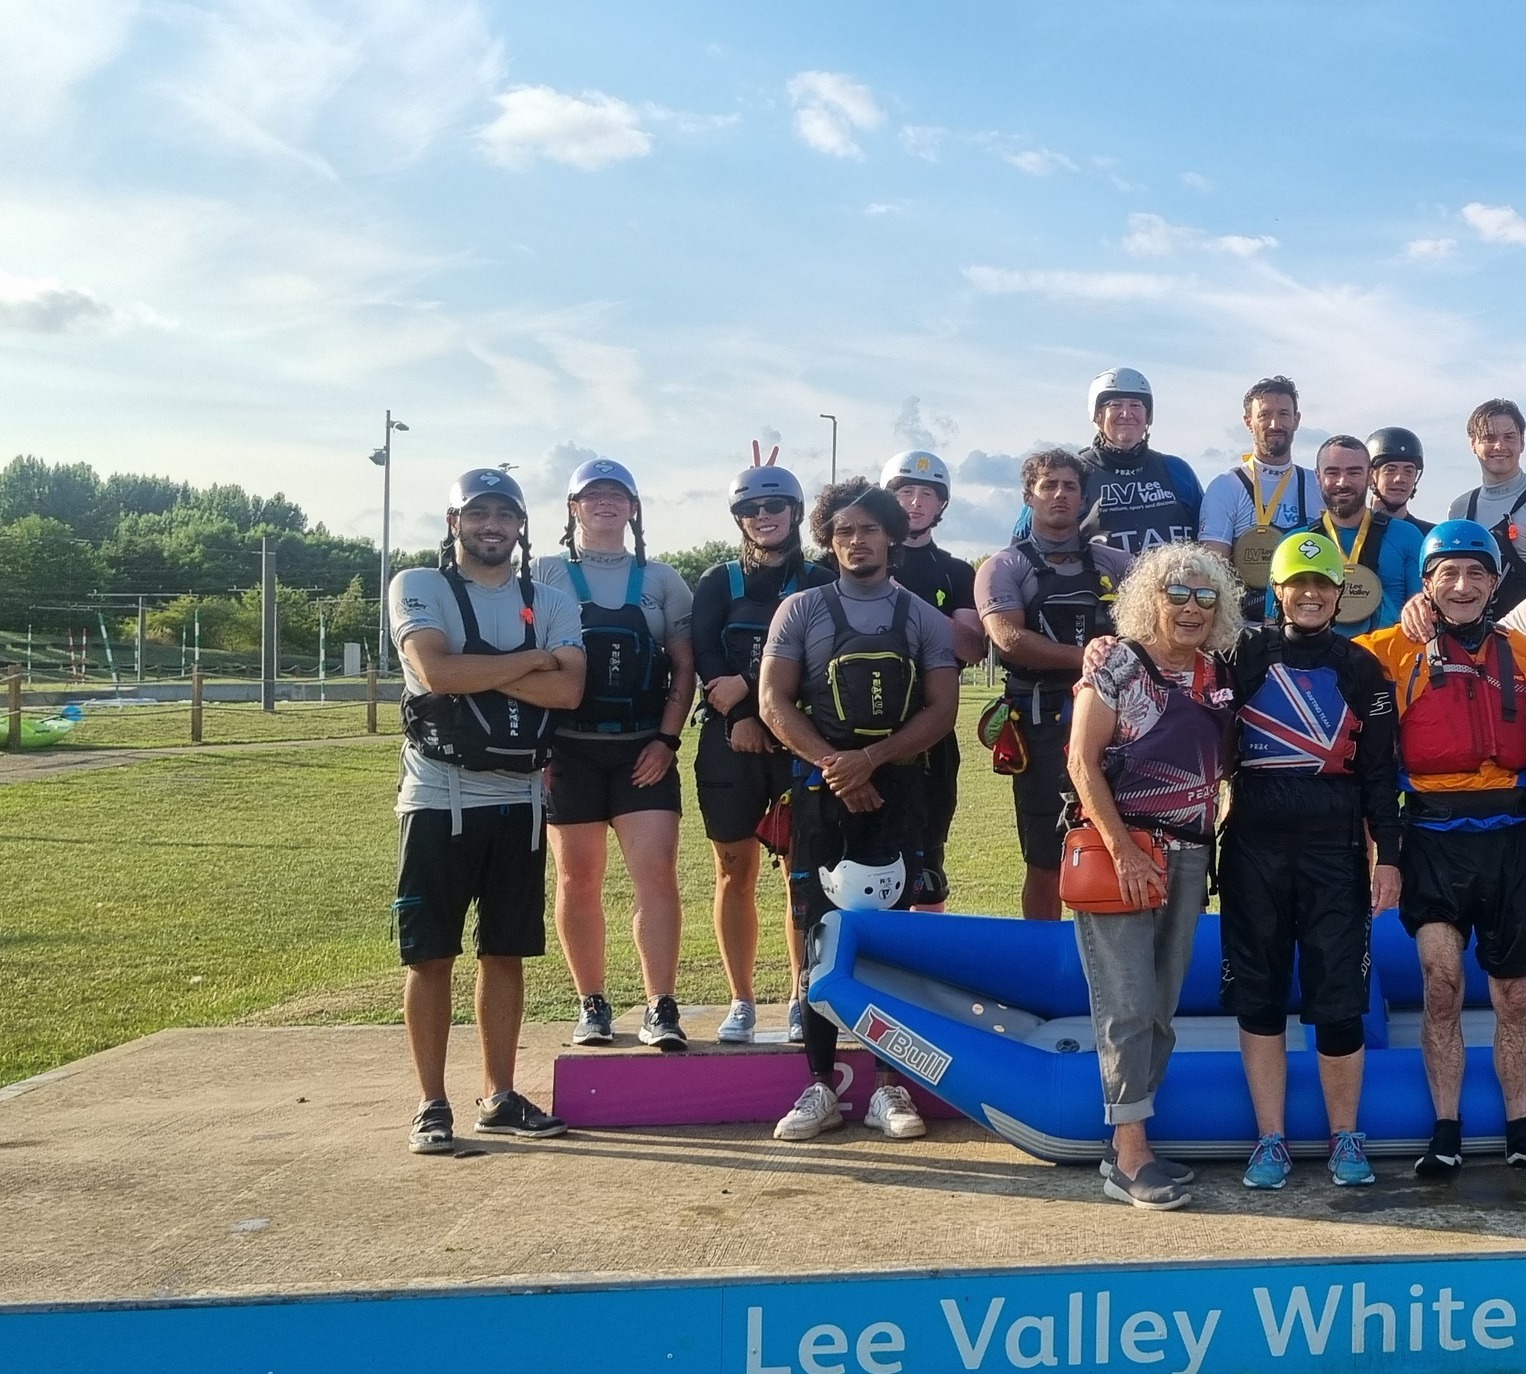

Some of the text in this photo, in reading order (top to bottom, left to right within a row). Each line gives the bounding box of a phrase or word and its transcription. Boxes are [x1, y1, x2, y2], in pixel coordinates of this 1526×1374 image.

[1137, 481, 1162, 492] Lee
[885, 1029, 946, 1081] Bull
[746, 1305, 906, 1374] Lee
[940, 1290, 1222, 1374] Valley
[1253, 1282, 1518, 1358] White
